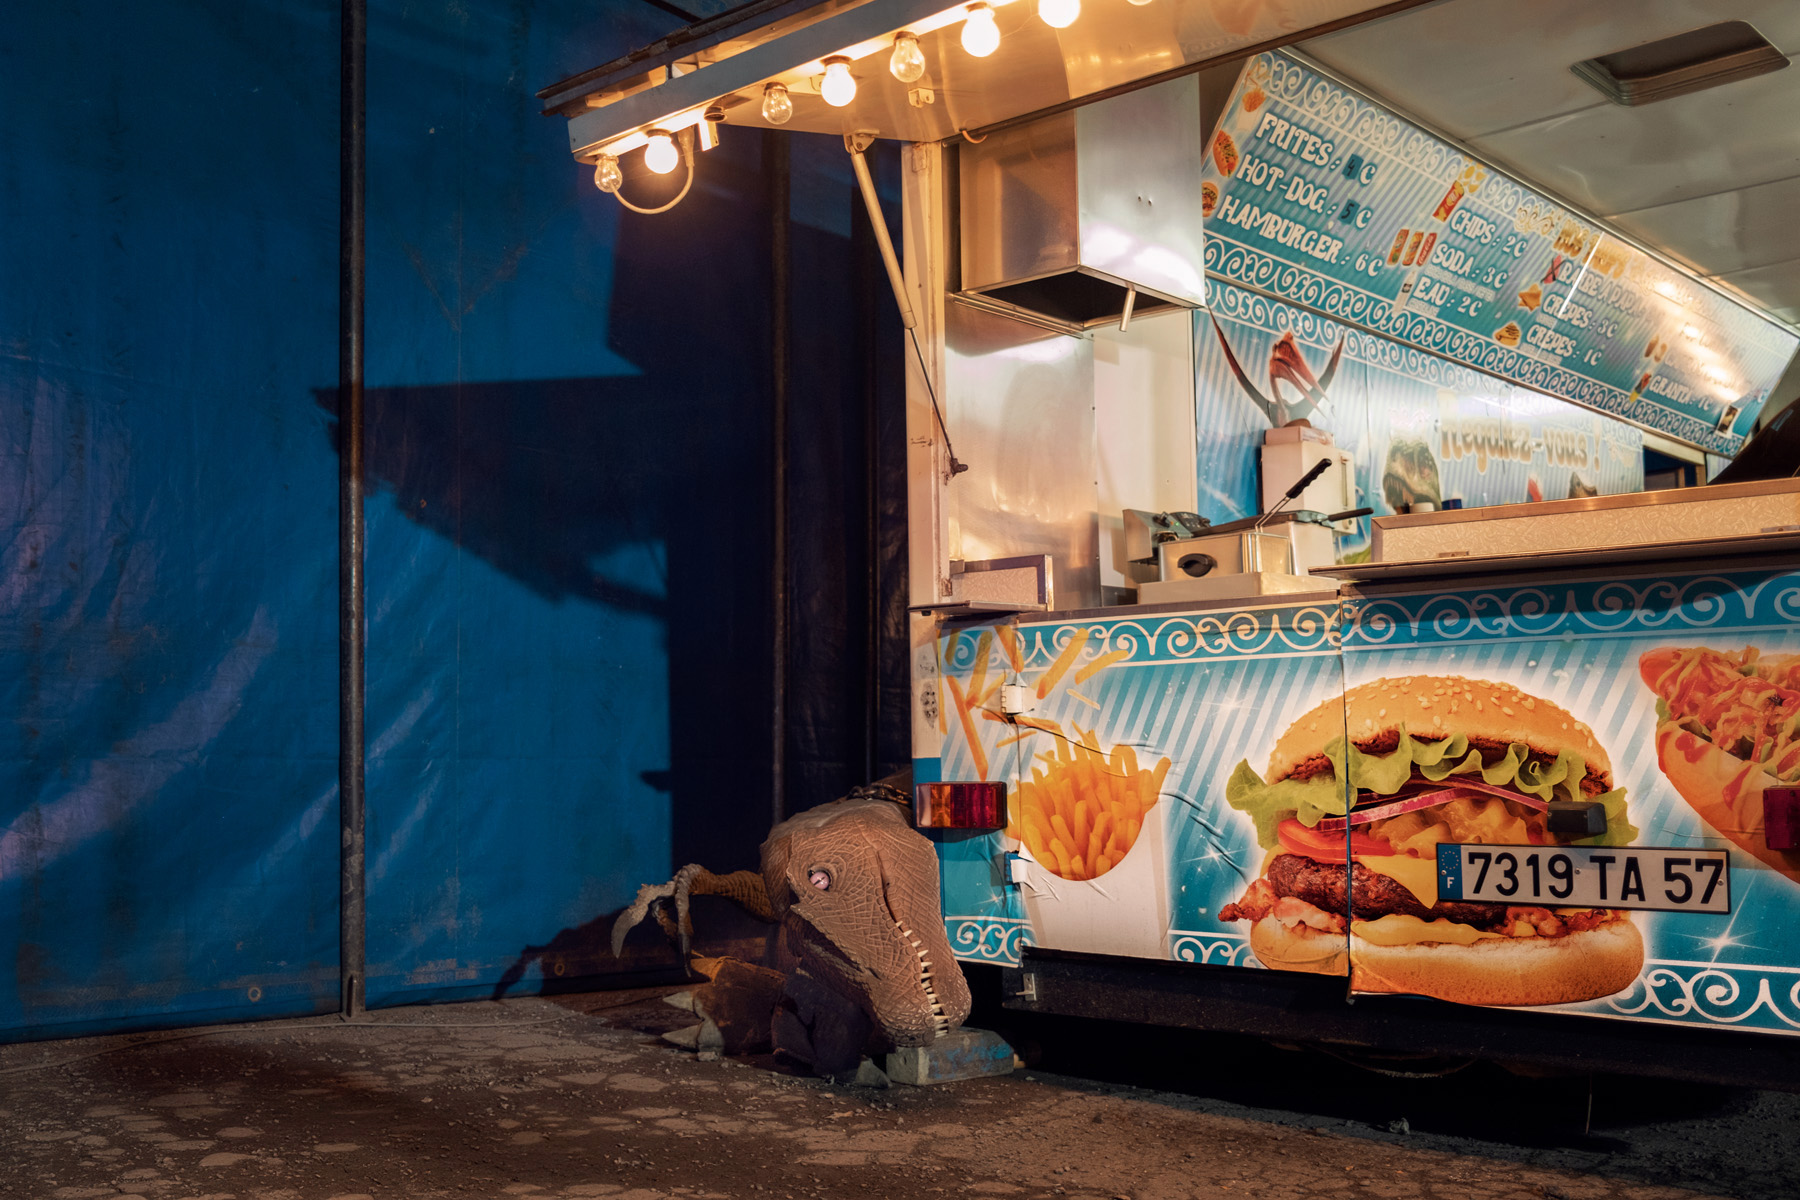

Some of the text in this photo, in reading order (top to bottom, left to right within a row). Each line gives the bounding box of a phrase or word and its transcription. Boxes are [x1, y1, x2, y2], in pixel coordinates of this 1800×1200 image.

[1446, 877, 1455, 889] F
[1468, 852, 1724, 905] 7319 TA 57
